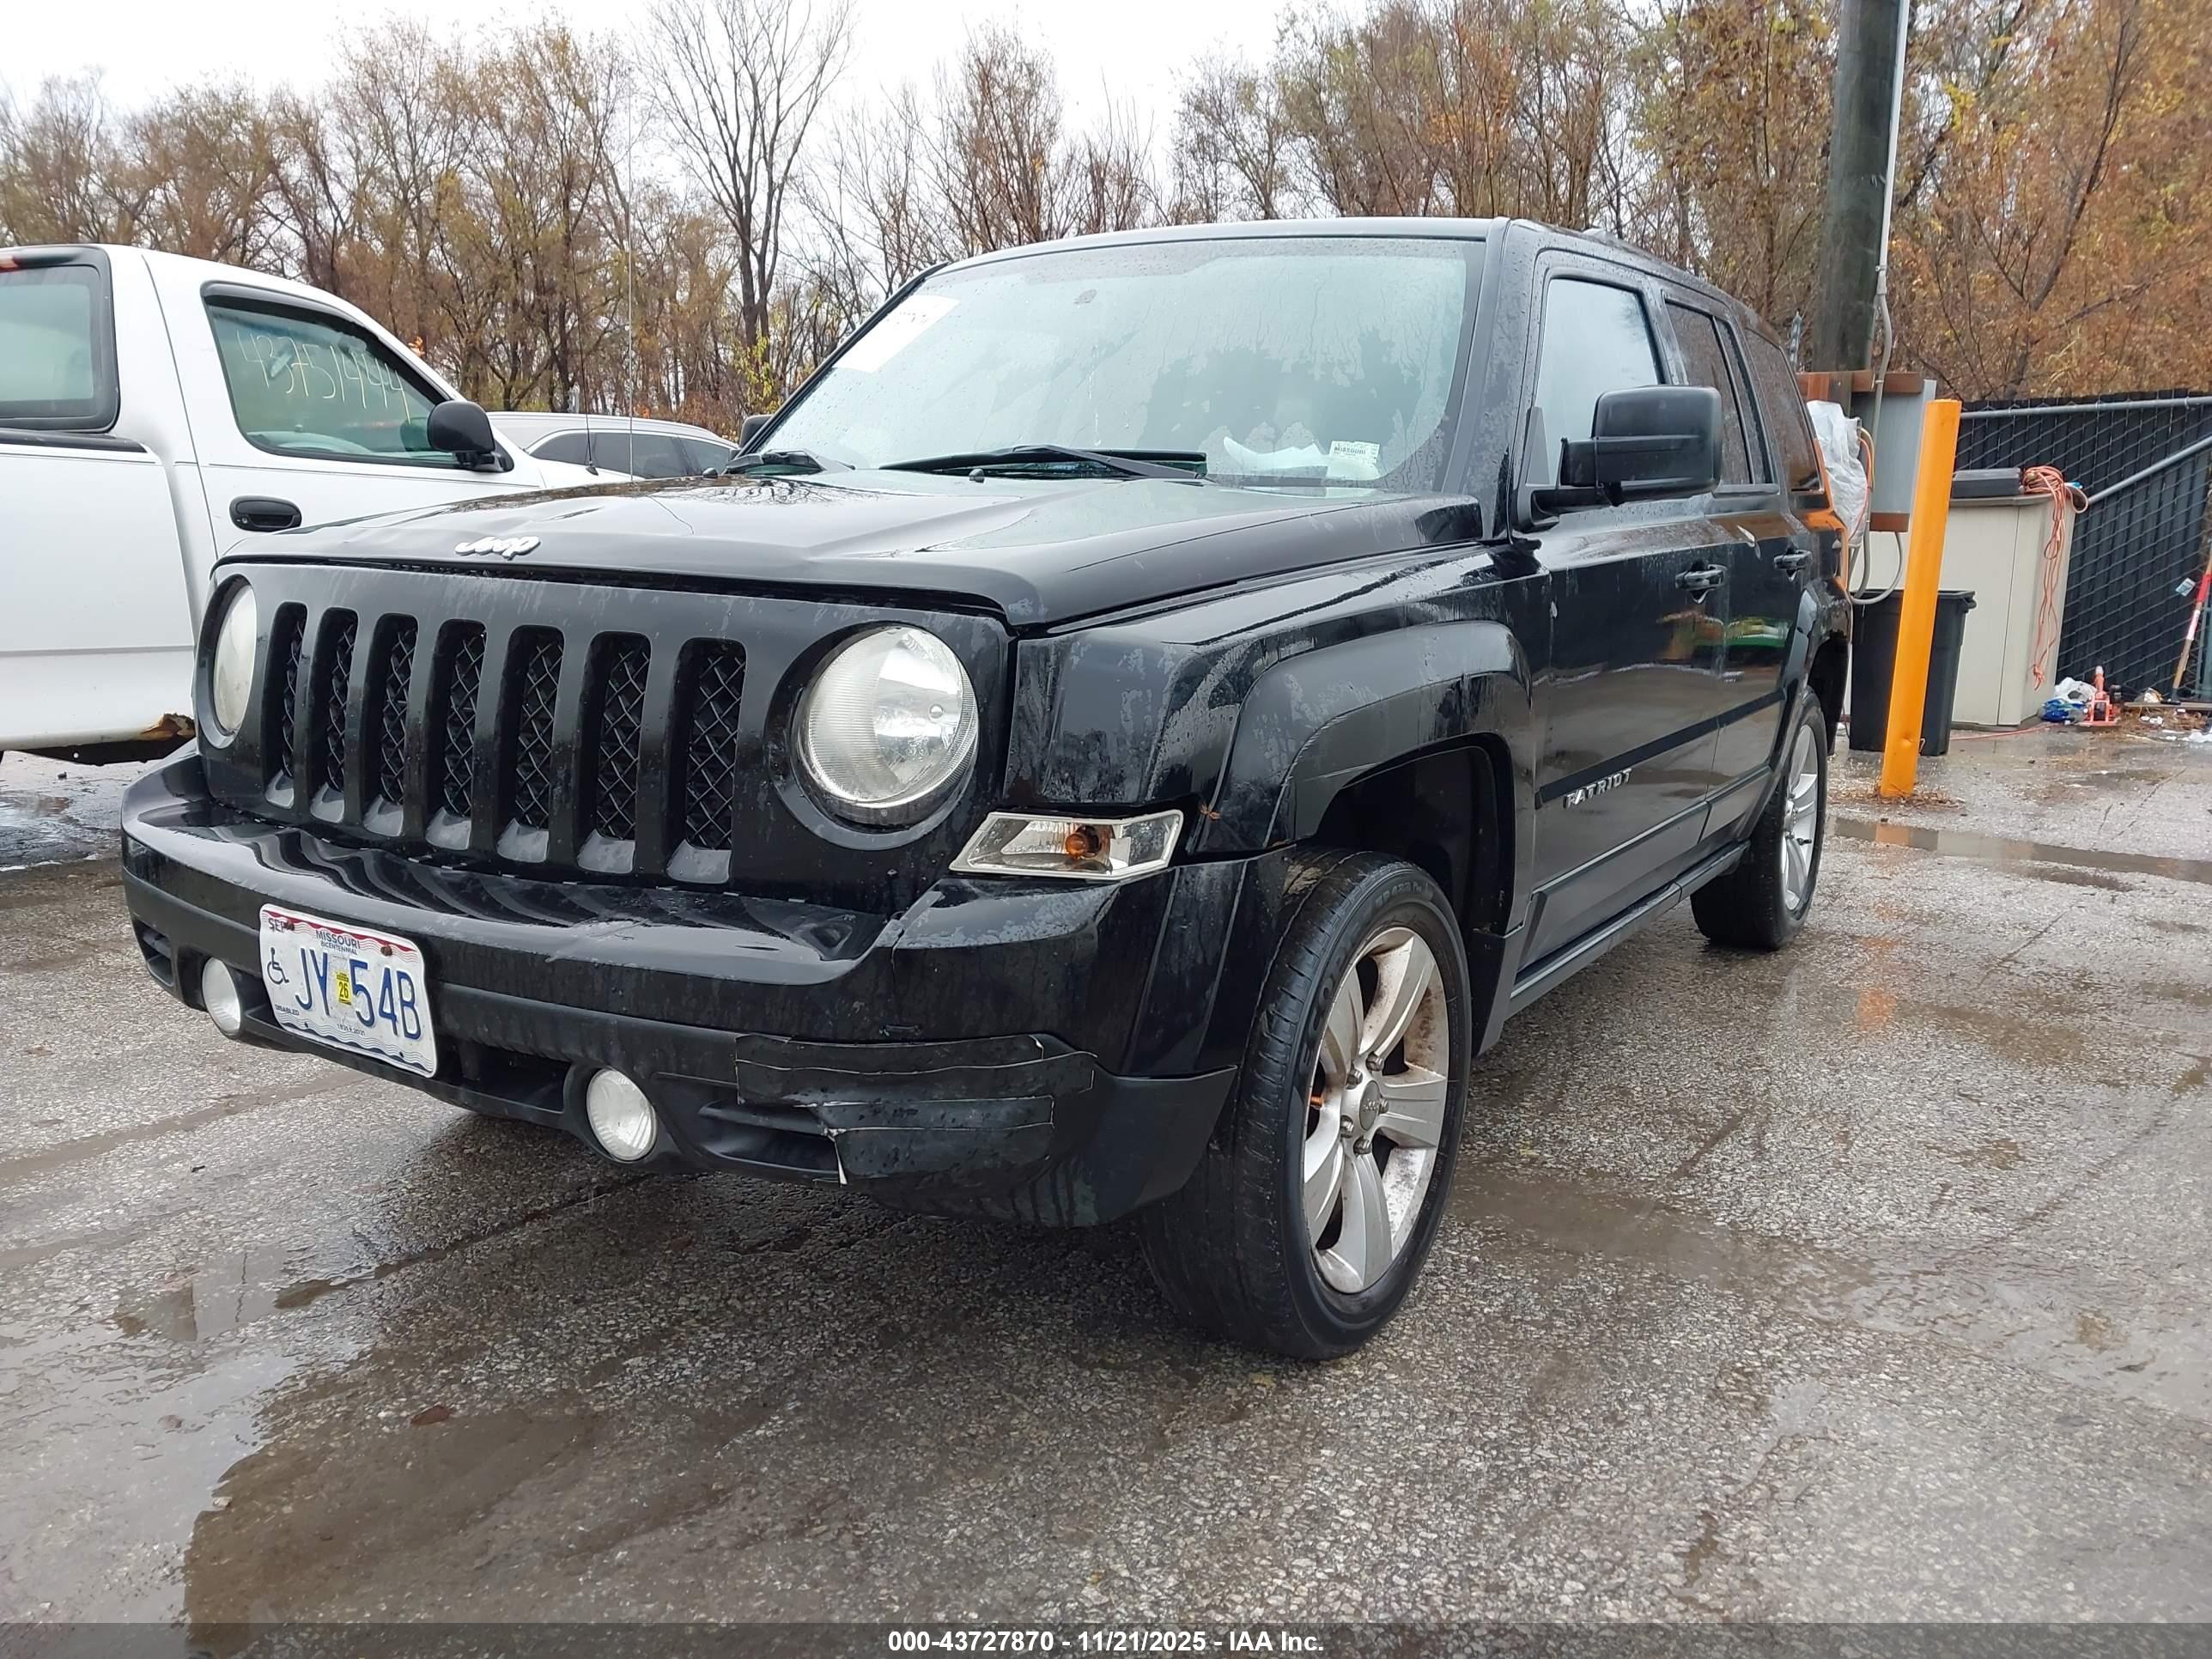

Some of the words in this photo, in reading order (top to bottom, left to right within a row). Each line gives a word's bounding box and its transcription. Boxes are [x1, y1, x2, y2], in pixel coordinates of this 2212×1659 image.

[454, 536, 541, 562] Jeep
[1566, 768, 1632, 808] PATRIOT
[316, 930, 361, 950] MISSOURI
[320, 941, 358, 955] BICENTENNIAL
[295, 947, 330, 1017] JY
[349, 958, 422, 1040] 54B
[339, 981, 349, 999] 26
[275, 1003, 300, 1016] DISABLED
